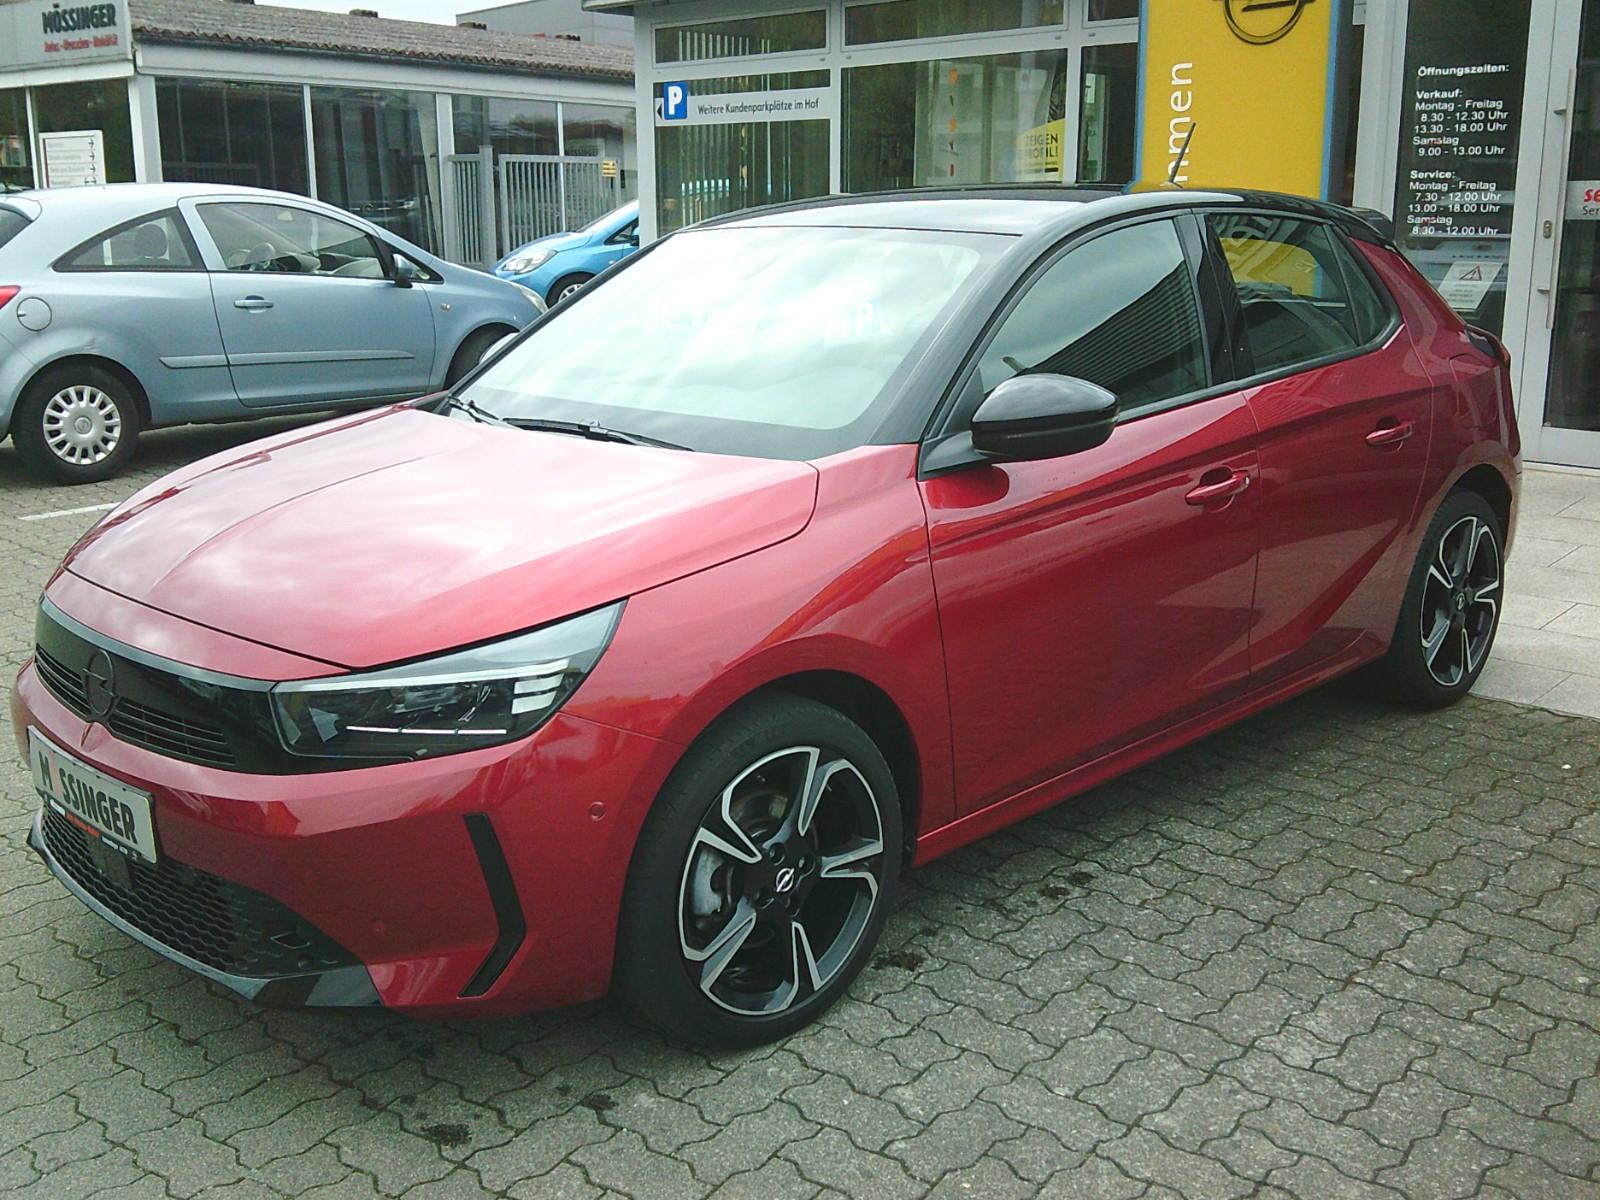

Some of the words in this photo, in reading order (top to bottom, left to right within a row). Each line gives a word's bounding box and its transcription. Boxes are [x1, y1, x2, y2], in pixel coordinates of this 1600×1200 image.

[42, 3, 117, 34] MÖSSINGER
[1417, 64, 1510, 77] Öffnungszeiten:
[1416, 88, 1463, 99] Verkauf:
[668, 85, 683, 115] P
[697, 104, 724, 115] Weitere
[725, 100, 793, 114] Kundenparkplätze
[794, 99, 803, 109] im
[804, 97, 819, 109] Hof
[1415, 102, 1455, 111] Montag
[1465, 99, 1504, 110] Freitag
[1420, 112, 1445, 122] 8.30
[1455, 111, 1485, 121] 12.30
[1488, 110, 1509, 120] Uhr
[1414, 124, 1443, 134] 13.30
[1454, 123, 1484, 132] 18.00
[1487, 122, 1508, 132] Uhr
[1412, 136, 1460, 146] Samstag
[1418, 147, 1441, 157] 9.00
[1452, 146, 1482, 156] 13.00
[1485, 145, 1506, 155] Uhr
[1410, 169, 1456, 179] Service:
[1409, 181, 1448, 192] Montag
[1458, 180, 1497, 191] Freitag
[1415, 192, 1438, 201] 7.30
[1448, 192, 1478, 201] 12.00
[1481, 191, 1502, 201] Uhr
[1408, 204, 1437, 213] 13.00
[1448, 203, 1477, 213] 18.00
[1480, 203, 1501, 213] Uhr
[1406, 215, 1453, 225] Samstag
[1412, 226, 1435, 235] 8.30
[1446, 226, 1475, 235] 12.00
[1478, 226, 1499, 236] Uhr
[38, 751, 138, 845] MSSINGER
